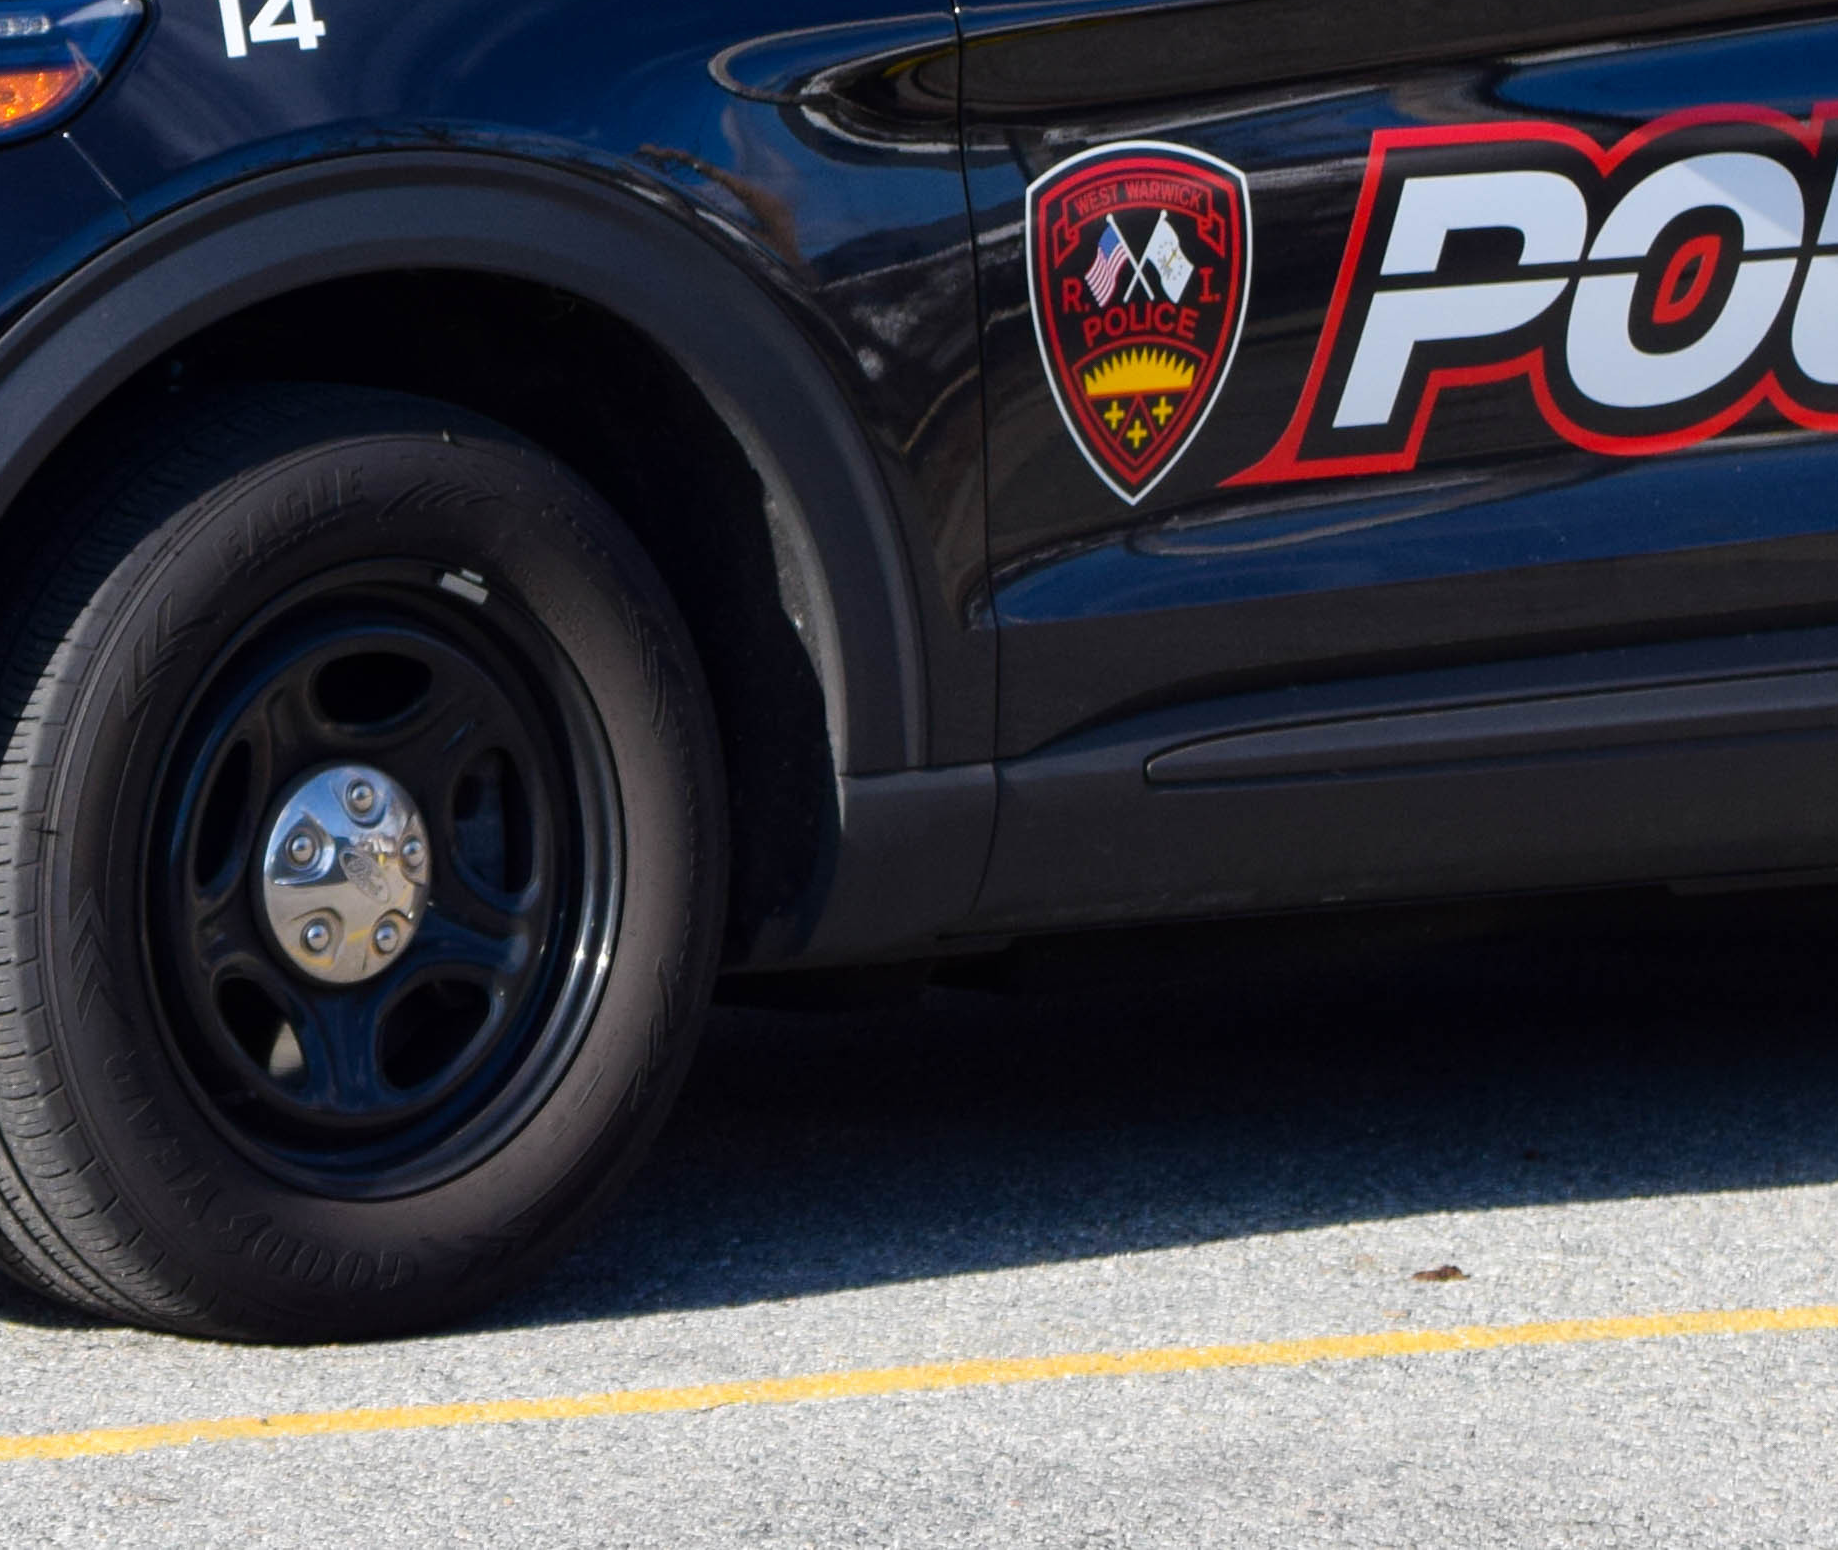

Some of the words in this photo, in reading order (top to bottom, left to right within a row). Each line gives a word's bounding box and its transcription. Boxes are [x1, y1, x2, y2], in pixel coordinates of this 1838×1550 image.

[1073, 182, 1119, 217] WEST
[1125, 178, 1205, 212] WARWICK
[1082, 302, 1201, 348] POLICE
